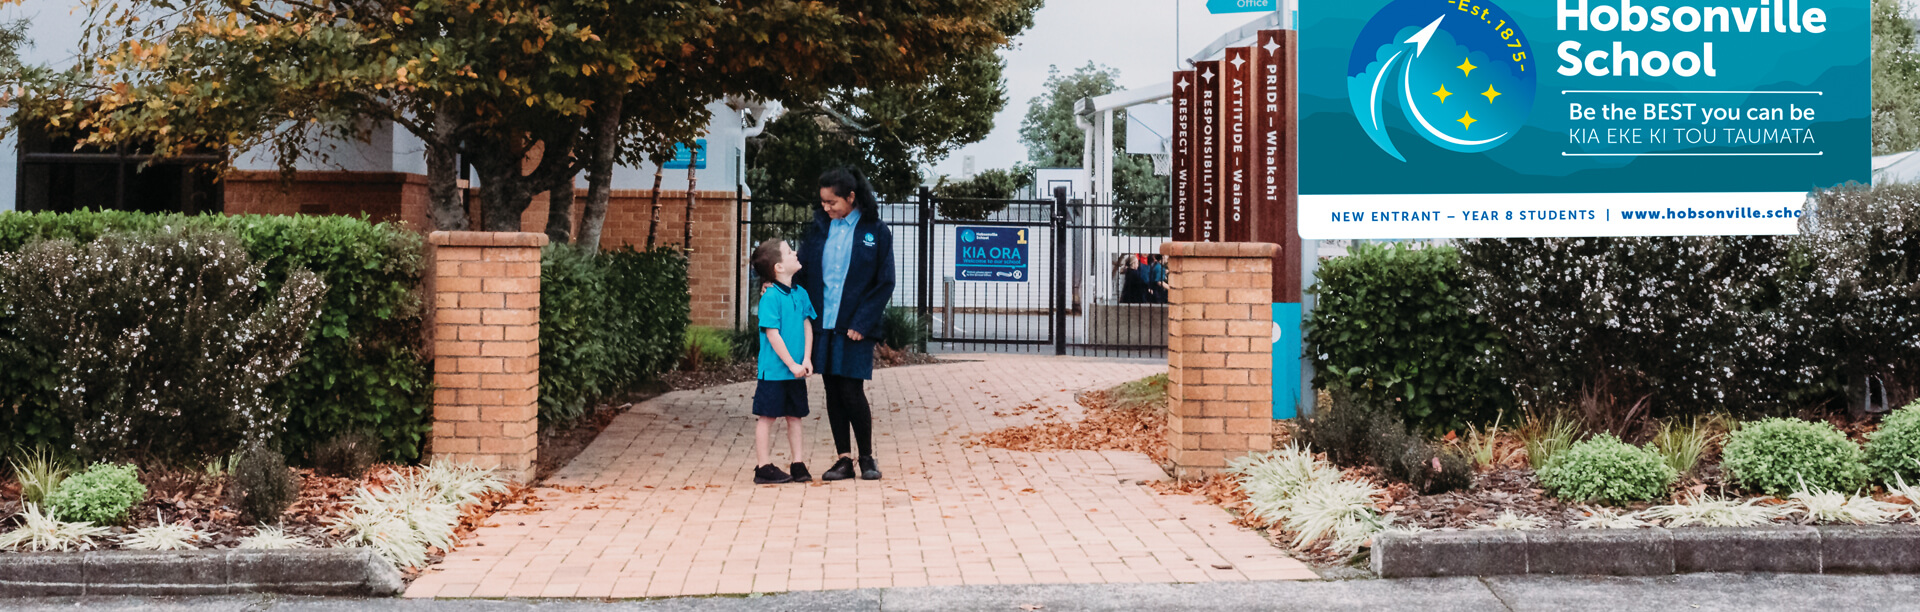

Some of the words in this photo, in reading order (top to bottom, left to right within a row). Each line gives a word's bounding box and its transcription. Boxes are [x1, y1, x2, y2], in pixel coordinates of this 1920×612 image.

[1557, 0, 1827, 33] Hobsonville
[1556, 40, 1716, 77] School
[1266, 64, 1278, 113] PRIDE
[1179, 98, 1188, 154] RESPECT
[1232, 78, 1243, 153] ATTITUDE
[1569, 102, 1596, 121] Be
[1601, 103, 1637, 121] the
[1643, 102, 1697, 121] BEST
[1701, 107, 1741, 125] you
[1746, 107, 1783, 121] can
[1790, 103, 1815, 121] be
[1203, 90, 1213, 205] RESPONSIBILITY
[1569, 128, 1600, 144] KIA
[1607, 128, 1642, 144] EKE
[1650, 128, 1666, 144] KI
[1673, 128, 1716, 144] TOU
[1723, 128, 1815, 144] TAUMATA
[1178, 169, 1188, 234] Whakaute
[1232, 169, 1243, 222] Waiaro
[1331, 211, 1365, 222] NEW
[1371, 211, 1441, 222] ENTRANT
[1462, 210, 1499, 221] YEAR
[1505, 210, 1513, 221] 8
[1519, 209, 1596, 221] STUDENTS
[962, 246, 986, 259] KIA
[989, 247, 1021, 260] ORA
[1016, 229, 1027, 244] 1
